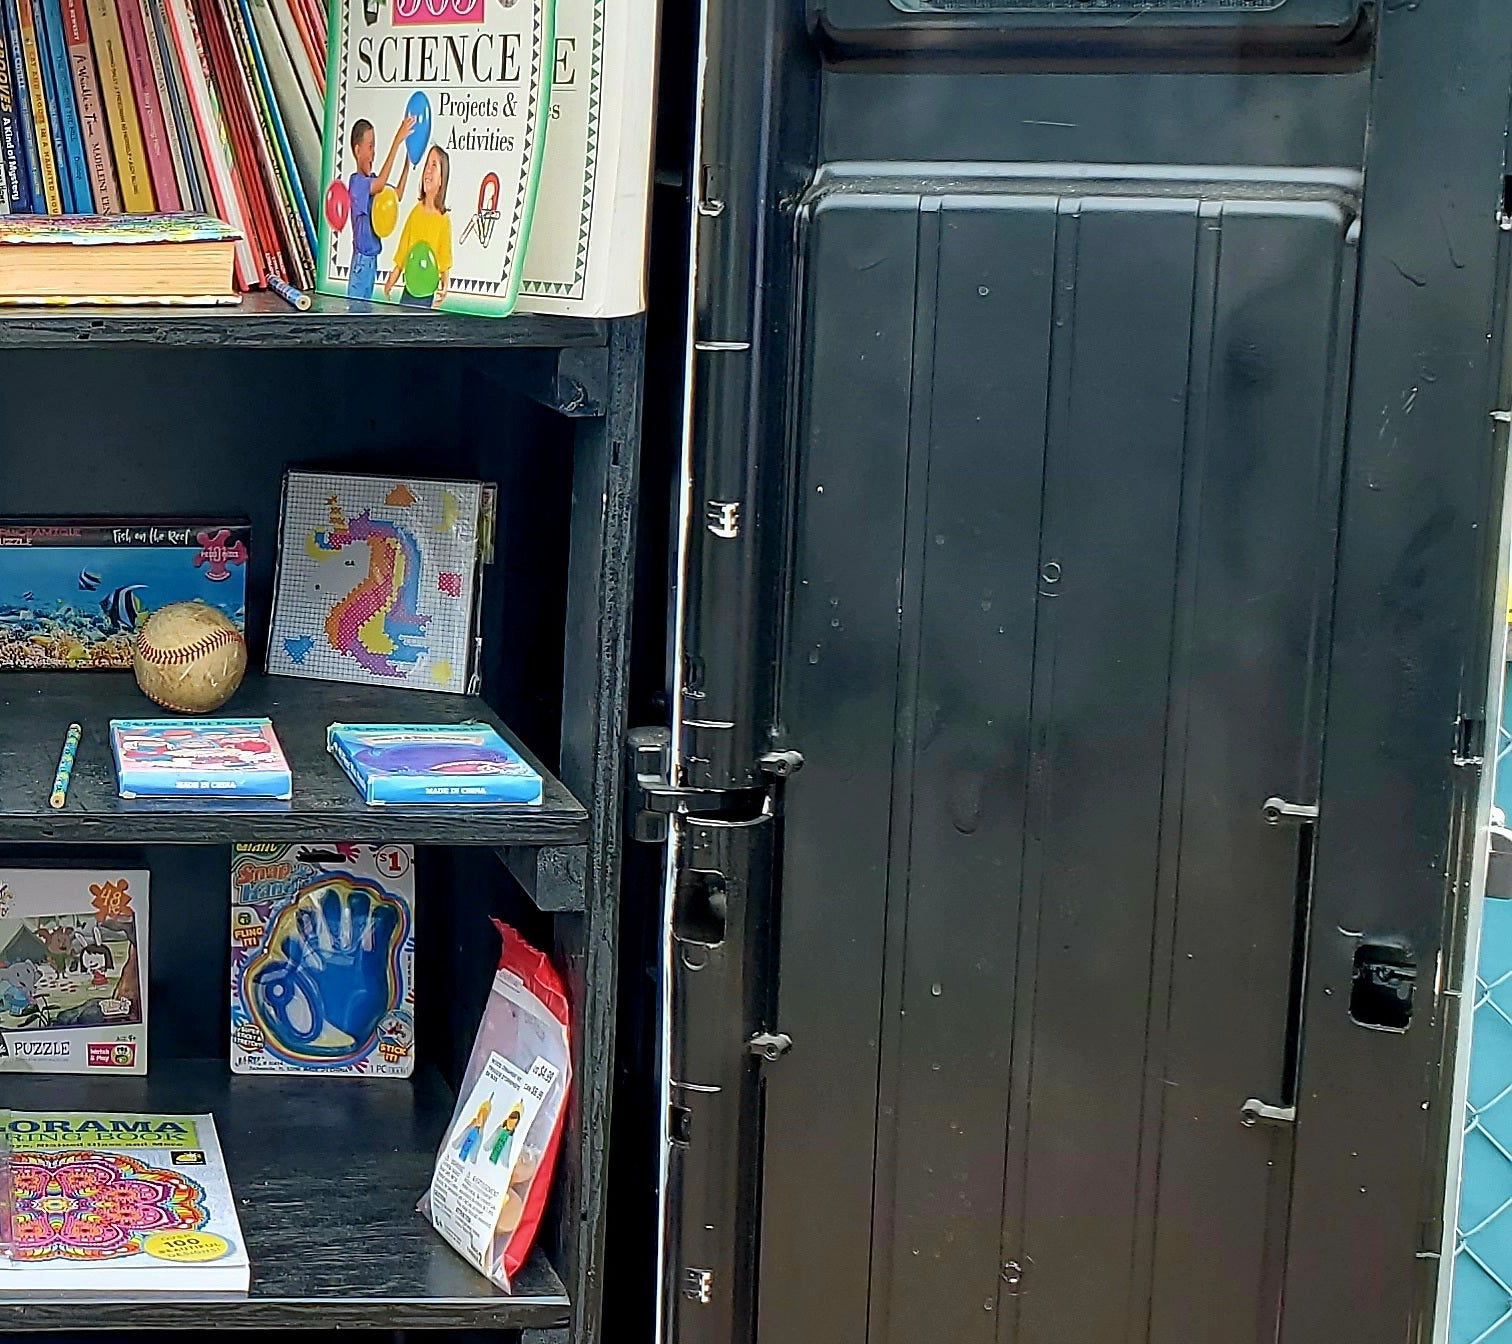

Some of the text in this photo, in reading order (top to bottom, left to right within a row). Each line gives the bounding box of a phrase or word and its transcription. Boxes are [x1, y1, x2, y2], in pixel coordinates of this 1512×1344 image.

[357, 33, 521, 84] SCIENCE
[439, 91, 518, 122] Projects &
[445, 126, 514, 152] Activities
[113, 529, 190, 544] Fish on the Reef
[207, 547, 227, 562] 101
[380, 851, 401, 871] $1
[100, 891, 121, 905] 48
[15, 1041, 70, 1055] PUZZLE
[164, 1238, 200, 1247] 100
